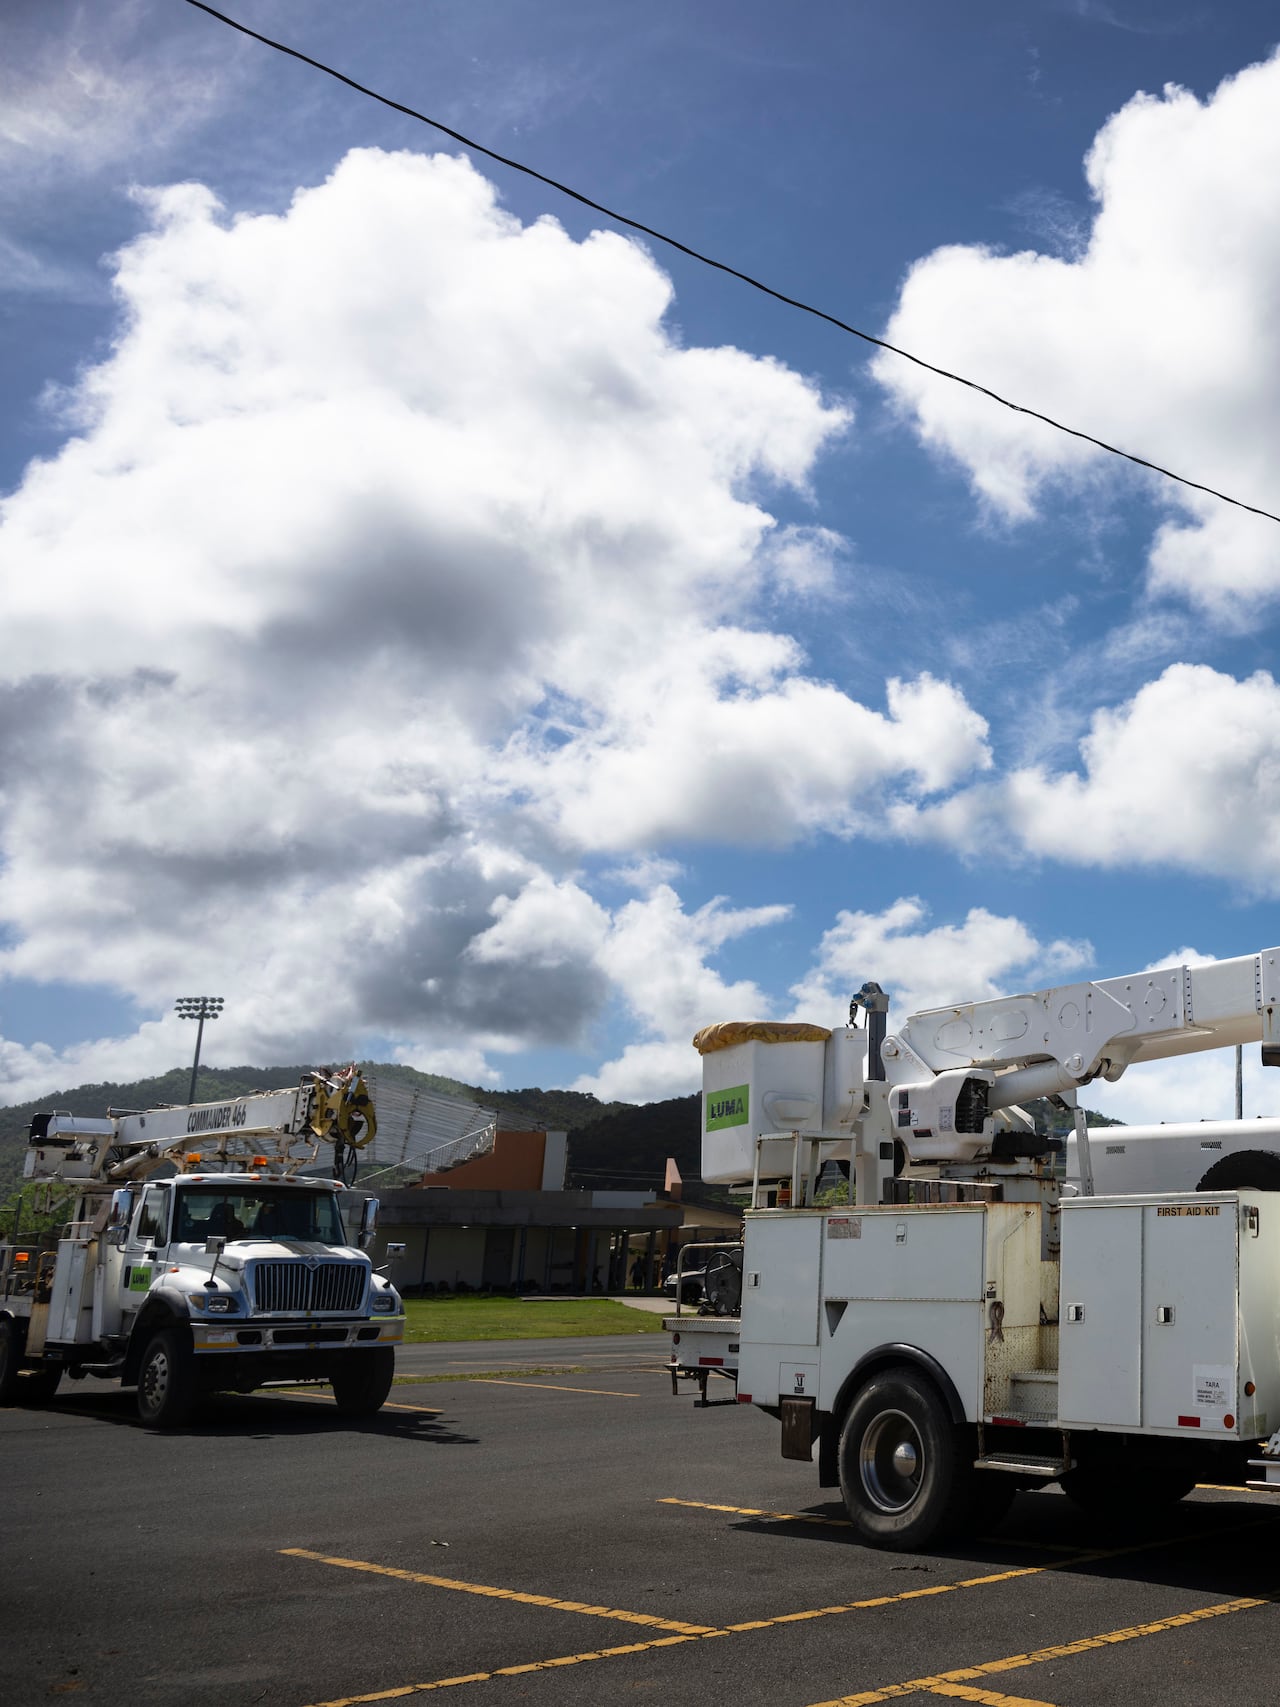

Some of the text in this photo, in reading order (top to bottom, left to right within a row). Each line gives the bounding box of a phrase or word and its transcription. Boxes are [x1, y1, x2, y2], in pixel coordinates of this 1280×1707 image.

[711, 1097, 744, 1119] LUMA
[187, 1104, 247, 1132] COMMANDER 466
[1157, 1206, 1220, 1216] FIRST AID KIT
[1205, 1381, 1220, 1389] TARA
